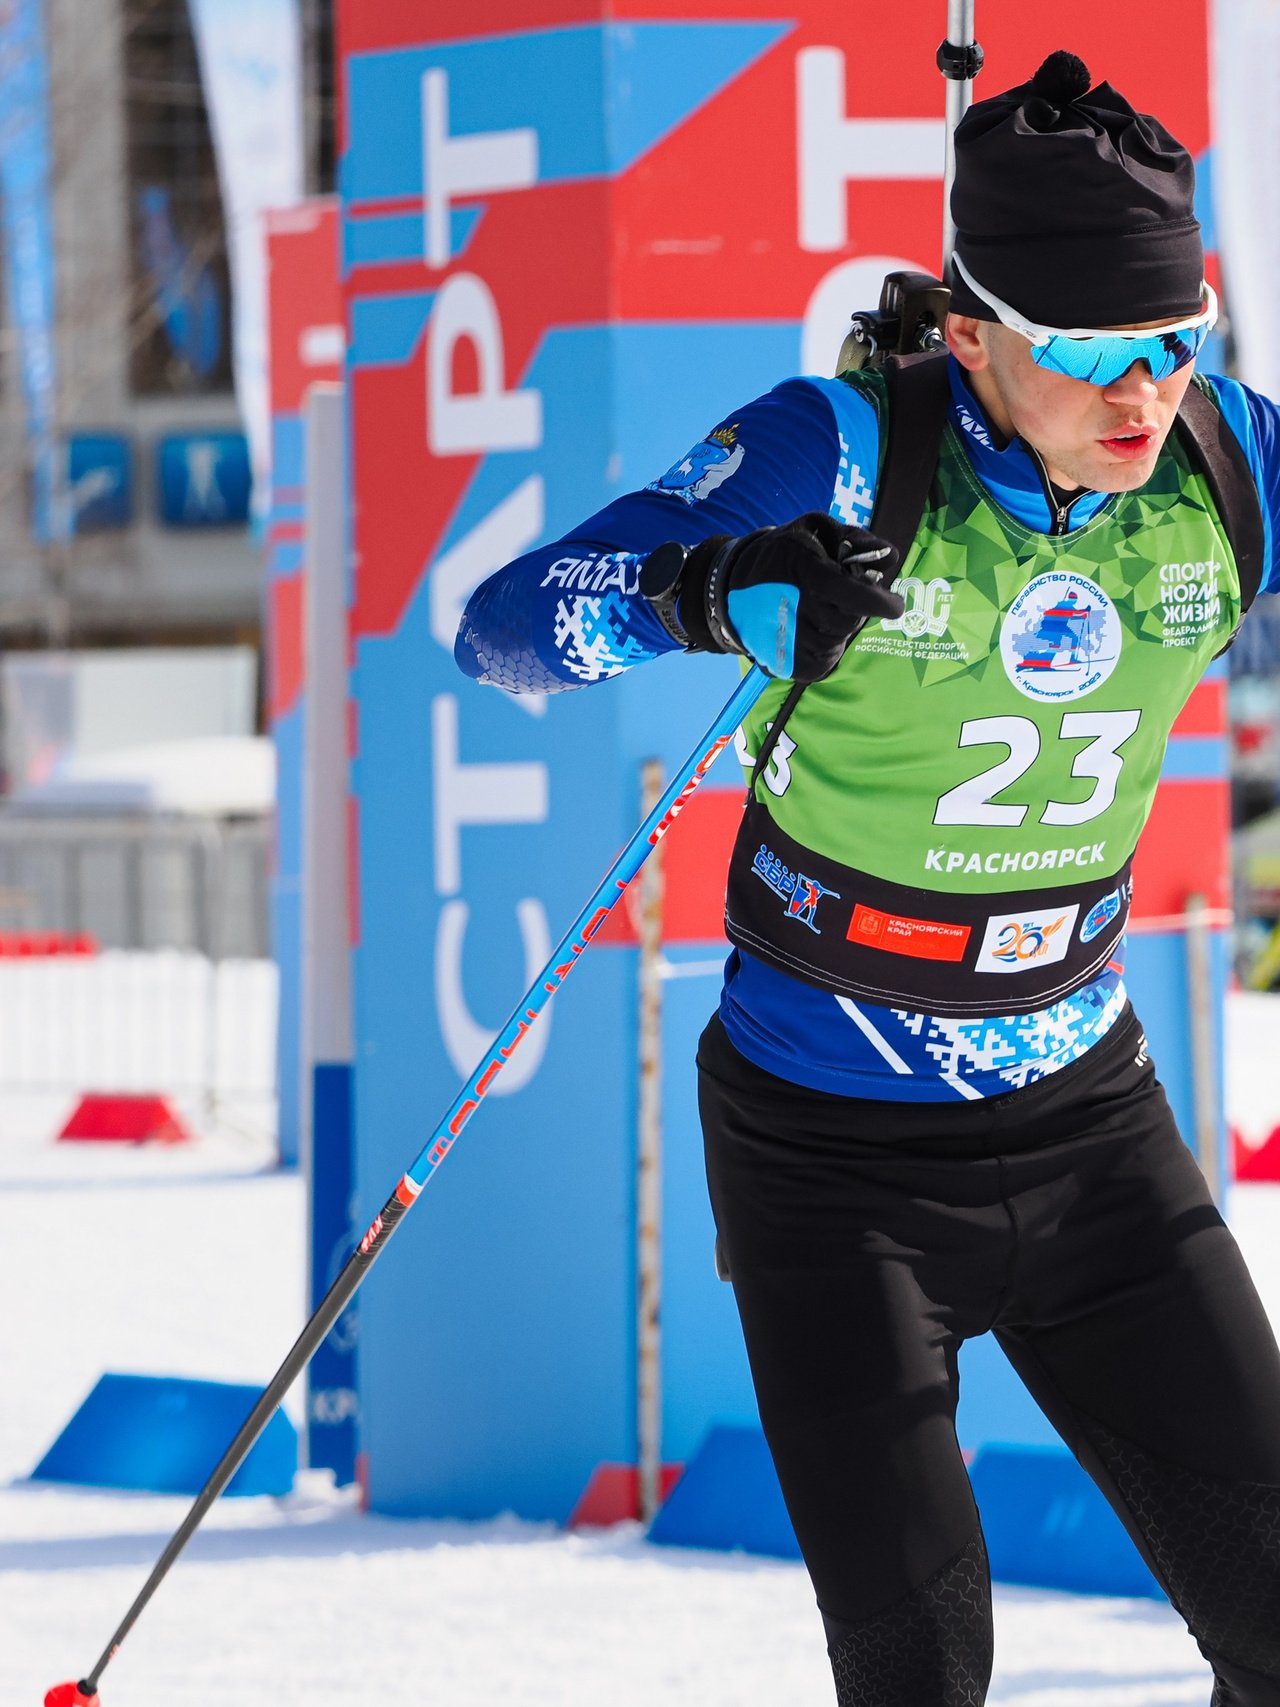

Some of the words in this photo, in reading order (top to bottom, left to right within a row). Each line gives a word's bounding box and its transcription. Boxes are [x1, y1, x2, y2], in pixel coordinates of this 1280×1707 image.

[956, 404, 995, 452] KV
[421, 66, 554, 1096] СТАРТ
[1011, 574, 1067, 615] ПЕРВЕНСТВО
[1069, 575, 1109, 608] РОССИИ
[1162, 597, 1220, 624] ЖИЗНИ
[855, 644, 913, 658] РОССИЙСКОЙ
[914, 650, 969, 660] ФЕДЕРАЦИИ
[861, 636, 931, 650] МИНИСТЕРСТВО
[933, 642, 966, 651] СПОРТА
[1162, 637, 1196, 648] ПРОЕКТ
[1022, 680, 1074, 697] Красноярск
[1078, 671, 1101, 691] 2023
[932, 709, 1142, 827] 23
[924, 841, 1107, 874] КРАСНОЯРСК
[754, 851, 796, 895] СБР
[886, 926, 912, 938] КРАЙ
[888, 919, 964, 937] КРАСНОЯРСКИЙ
